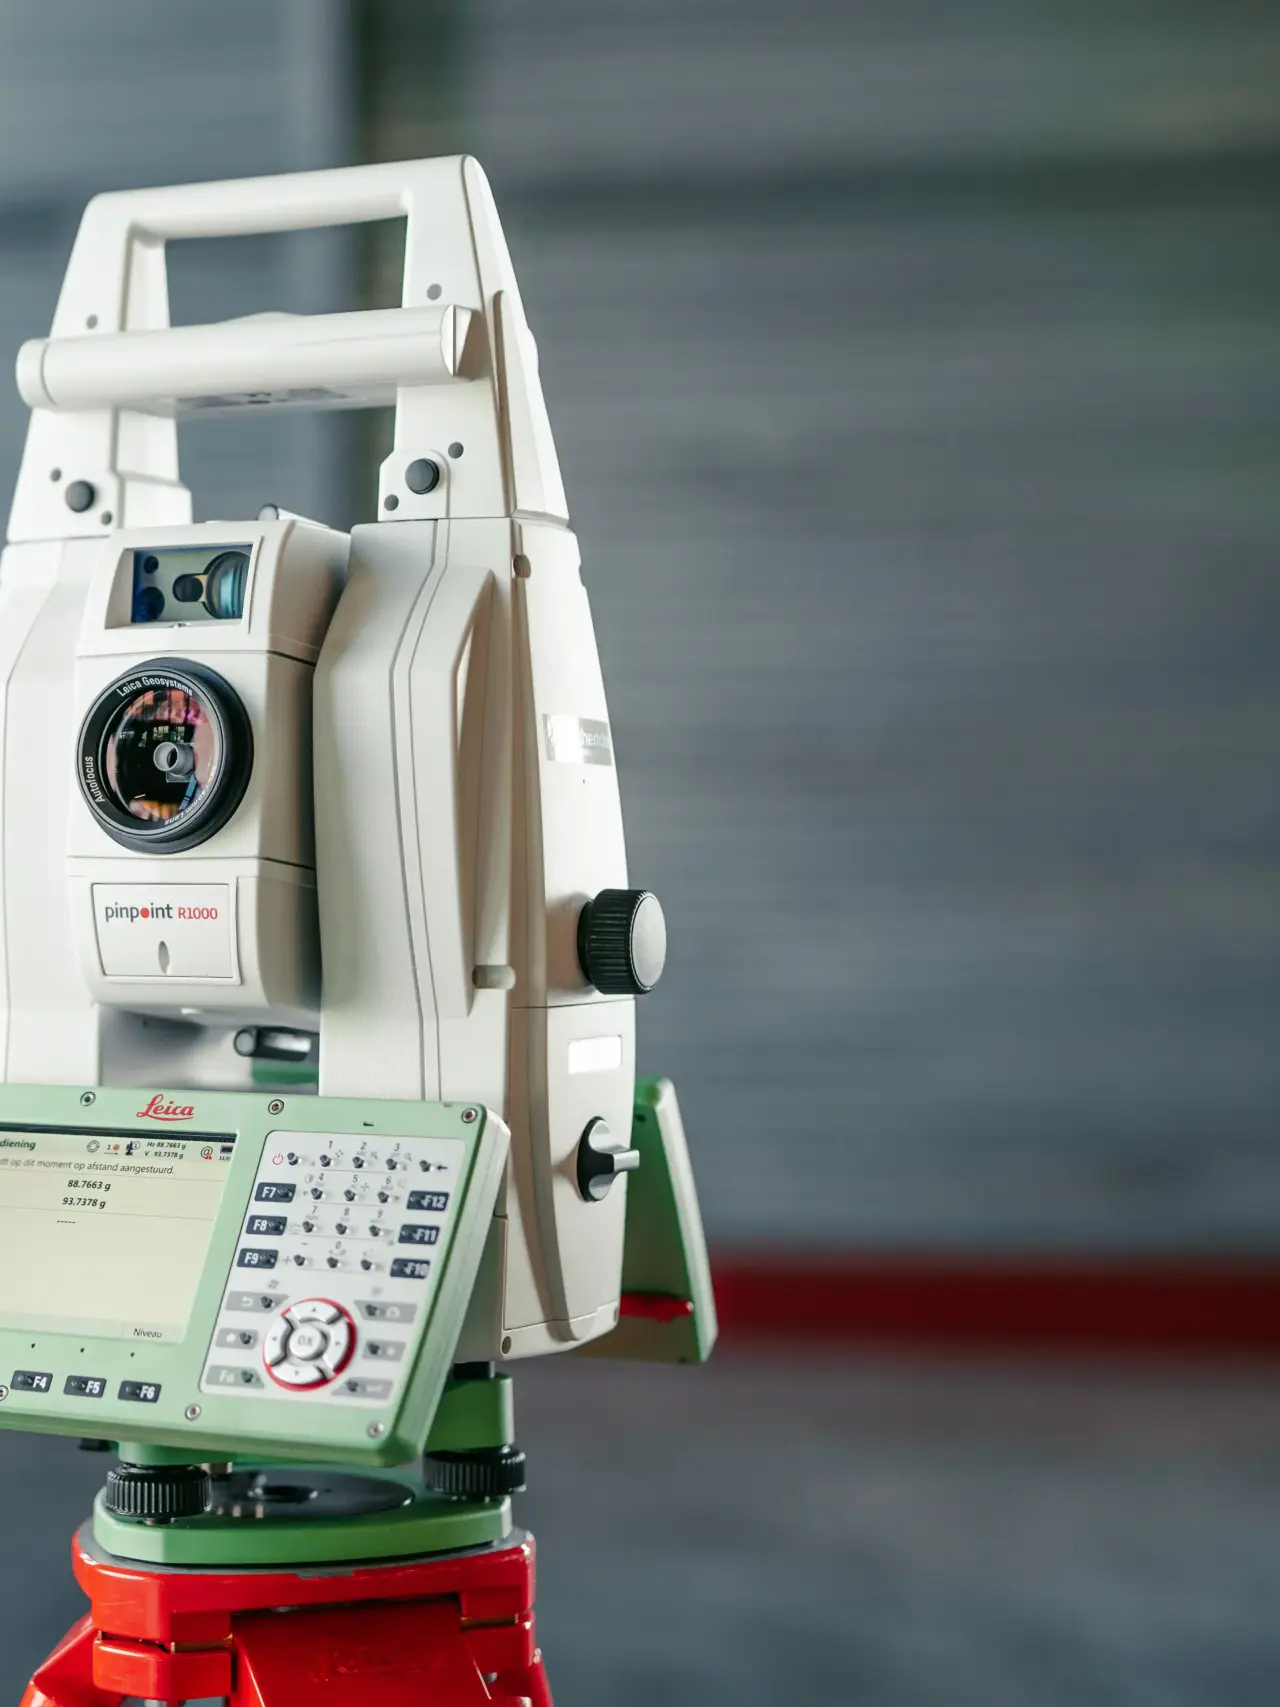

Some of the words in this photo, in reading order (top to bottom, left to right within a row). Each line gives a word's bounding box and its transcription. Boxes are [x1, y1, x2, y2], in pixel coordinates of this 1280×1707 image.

[116, 680, 142, 697] Leica
[141, 676, 194, 696] Geosystems
[85, 756, 106, 803] Autofocus
[164, 812, 185, 826] Lens
[105, 902, 173, 923] pinpoint
[178, 907, 218, 920] R1000
[136, 1093, 194, 1122] Leica
[153, 1151, 178, 1159] 93.7378
[10, 1159, 22, 1167] op
[23, 1158, 35, 1167] dit
[37, 1160, 72, 1169] moment
[73, 1162, 85, 1170] op
[86, 1162, 119, 1172] afstand
[120, 1164, 175, 1175] aangestuurd.
[67, 1179, 103, 1190] 88.7663
[104, 1182, 111, 1191] g
[262, 1187, 277, 1199] F7
[62, 1197, 98, 1207] 93.7378
[99, 1199, 106, 1209] g
[423, 1195, 446, 1209] F12
[253, 1219, 268, 1231] F8
[244, 1252, 259, 1264] F9
[133, 1328, 163, 1339] Niveau
[32, 1376, 47, 1389] F4
[86, 1380, 101, 1394] F5
[140, 1385, 156, 1399] F6
